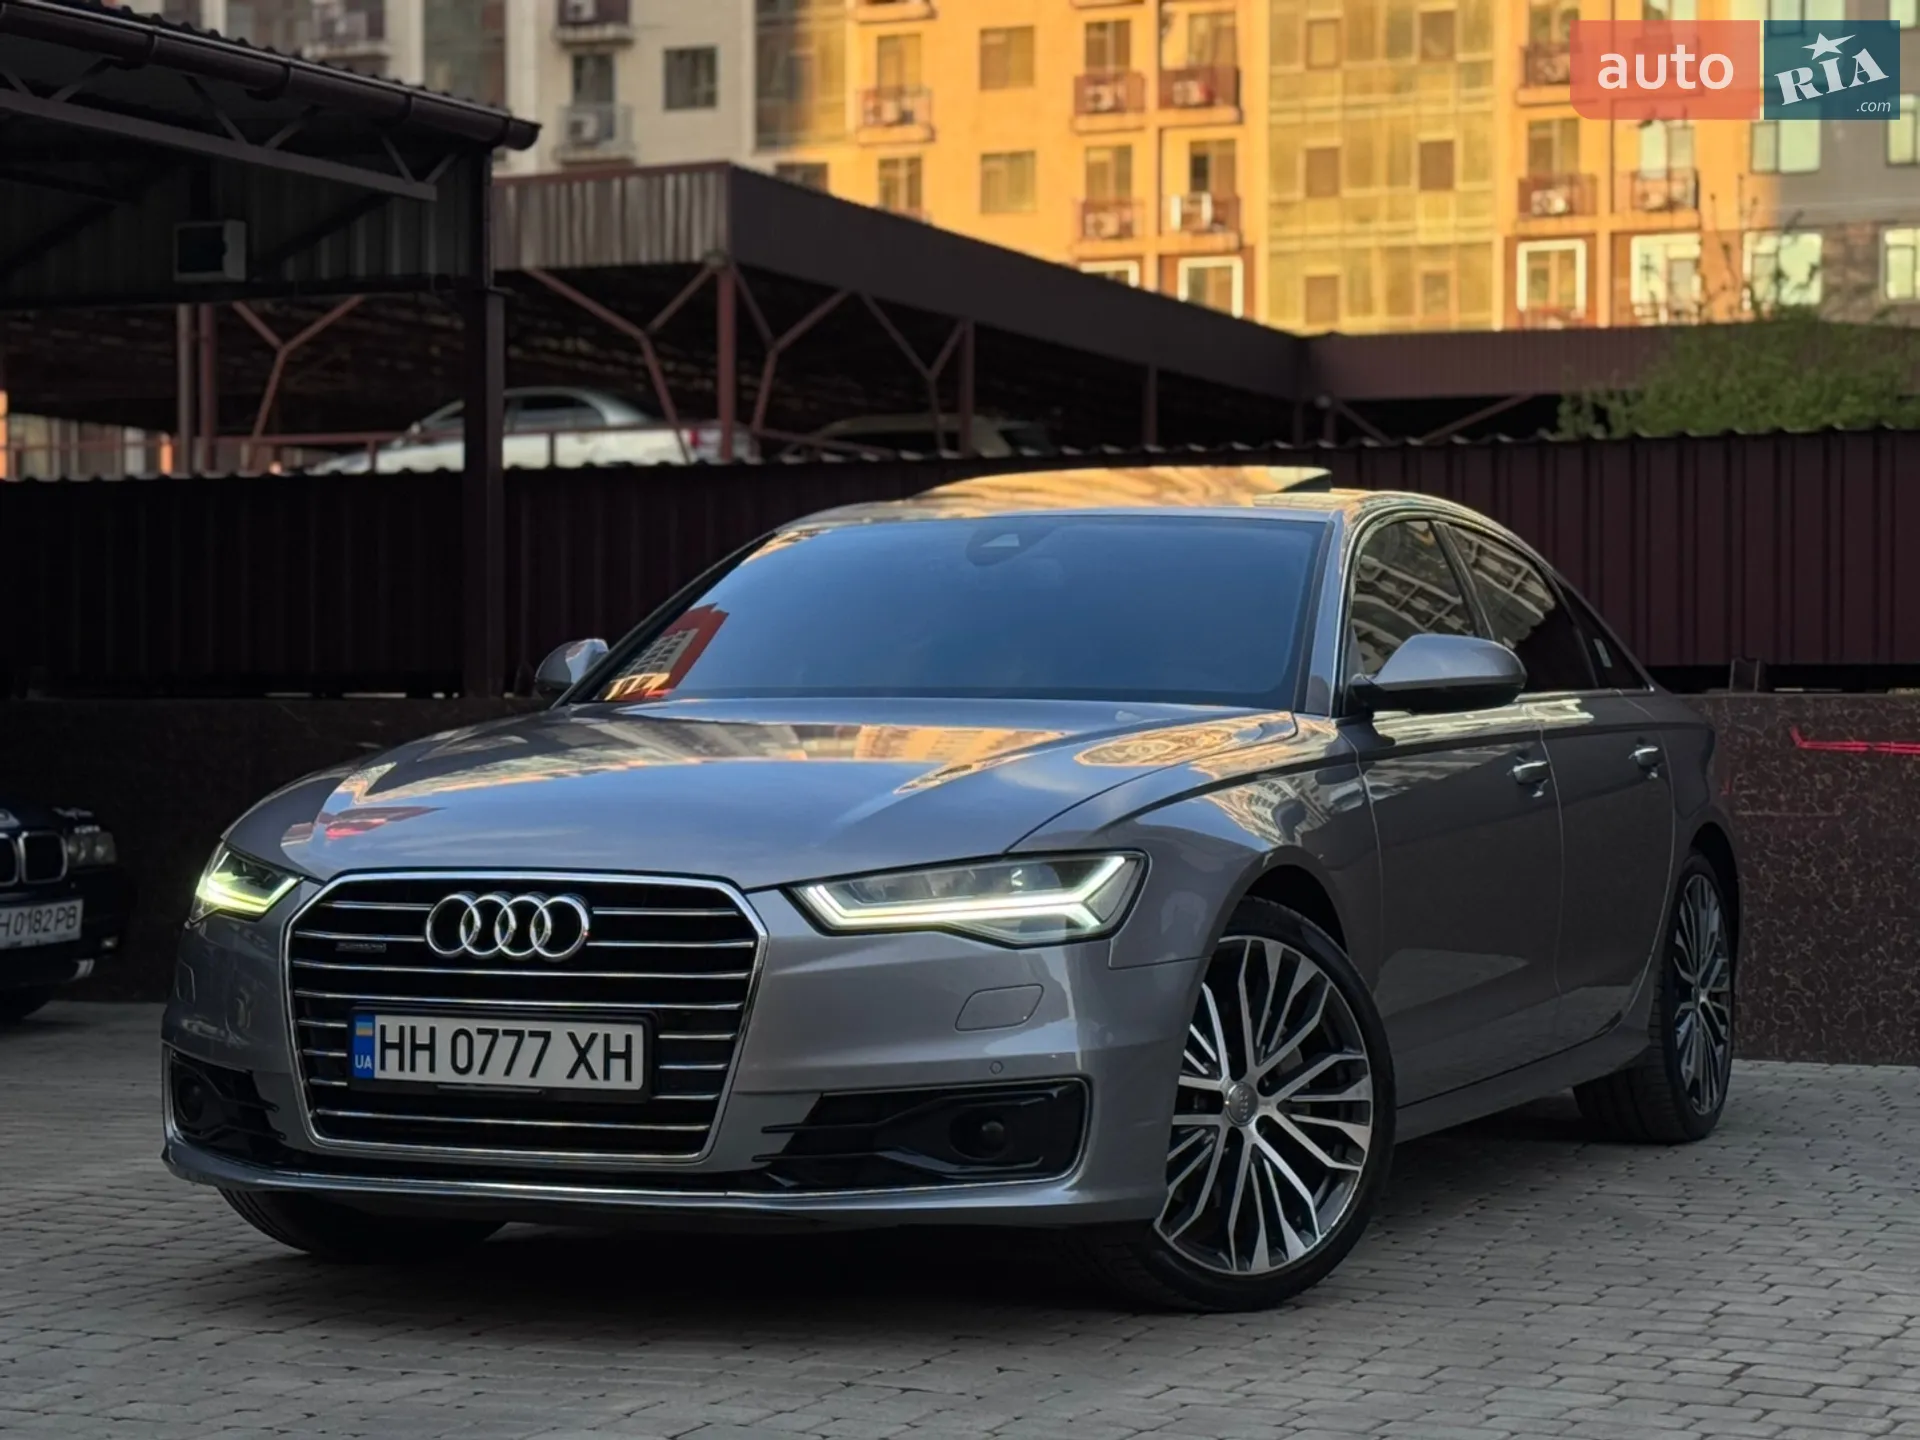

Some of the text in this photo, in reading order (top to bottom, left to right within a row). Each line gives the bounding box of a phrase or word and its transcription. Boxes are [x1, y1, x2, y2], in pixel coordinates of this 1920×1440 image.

[354, 1054, 373, 1070] UA
[379, 1024, 633, 1082] HH 0777 XH
